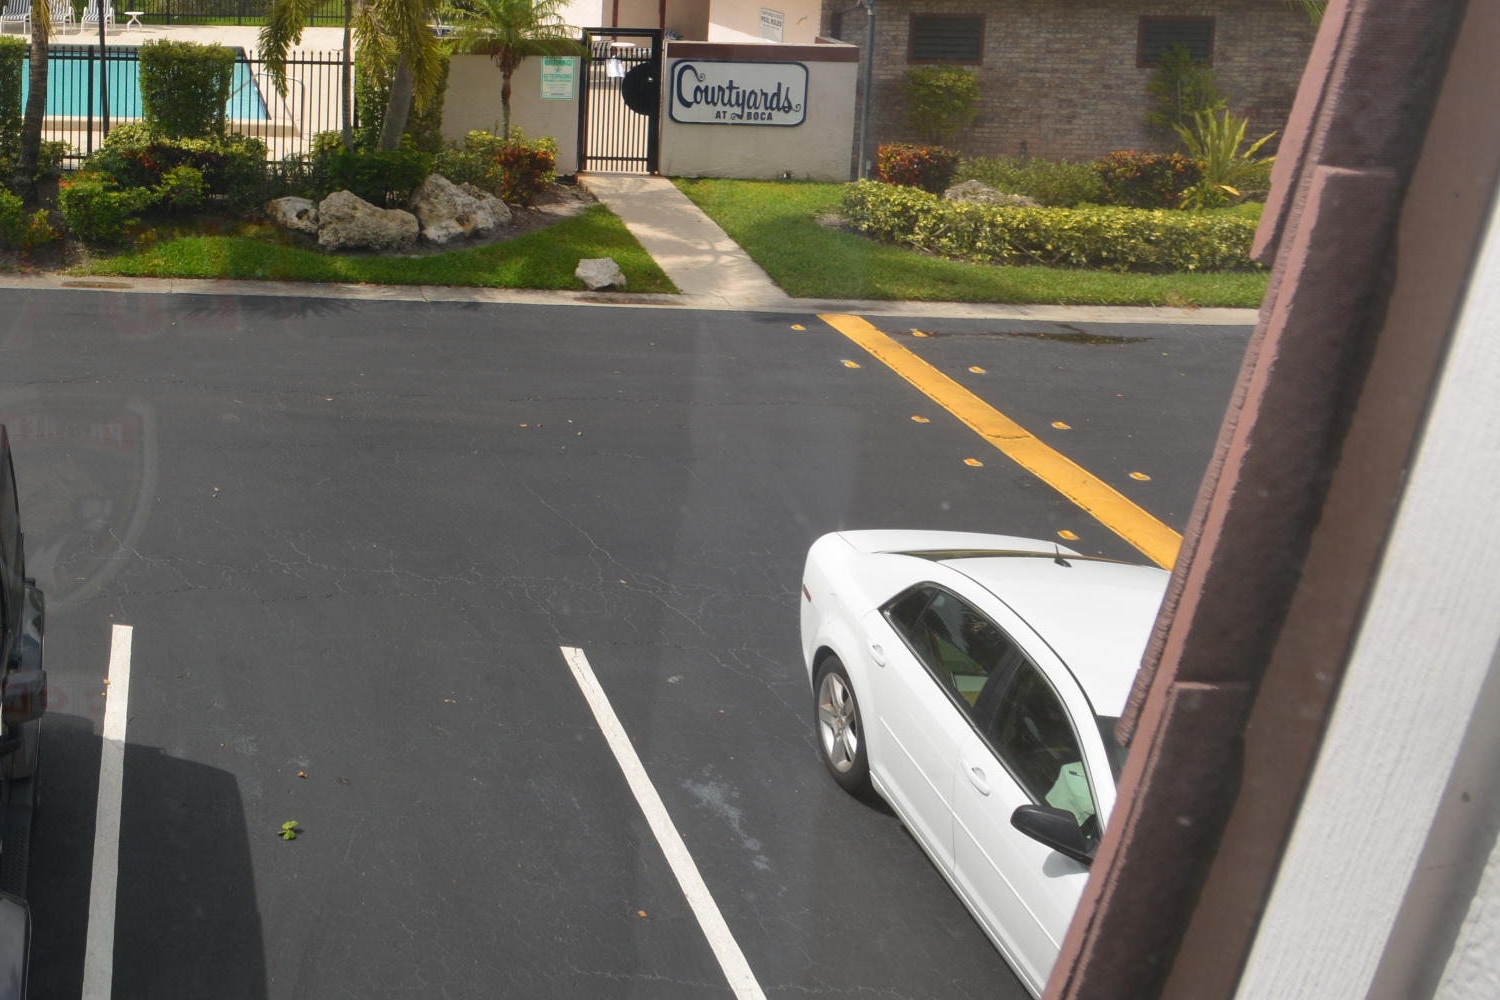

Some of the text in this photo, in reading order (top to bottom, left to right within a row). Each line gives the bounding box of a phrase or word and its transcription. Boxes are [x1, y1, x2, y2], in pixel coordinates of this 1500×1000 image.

[677, 65, 801, 120] Courtyards
[715, 110, 773, 120] AT BOCA
